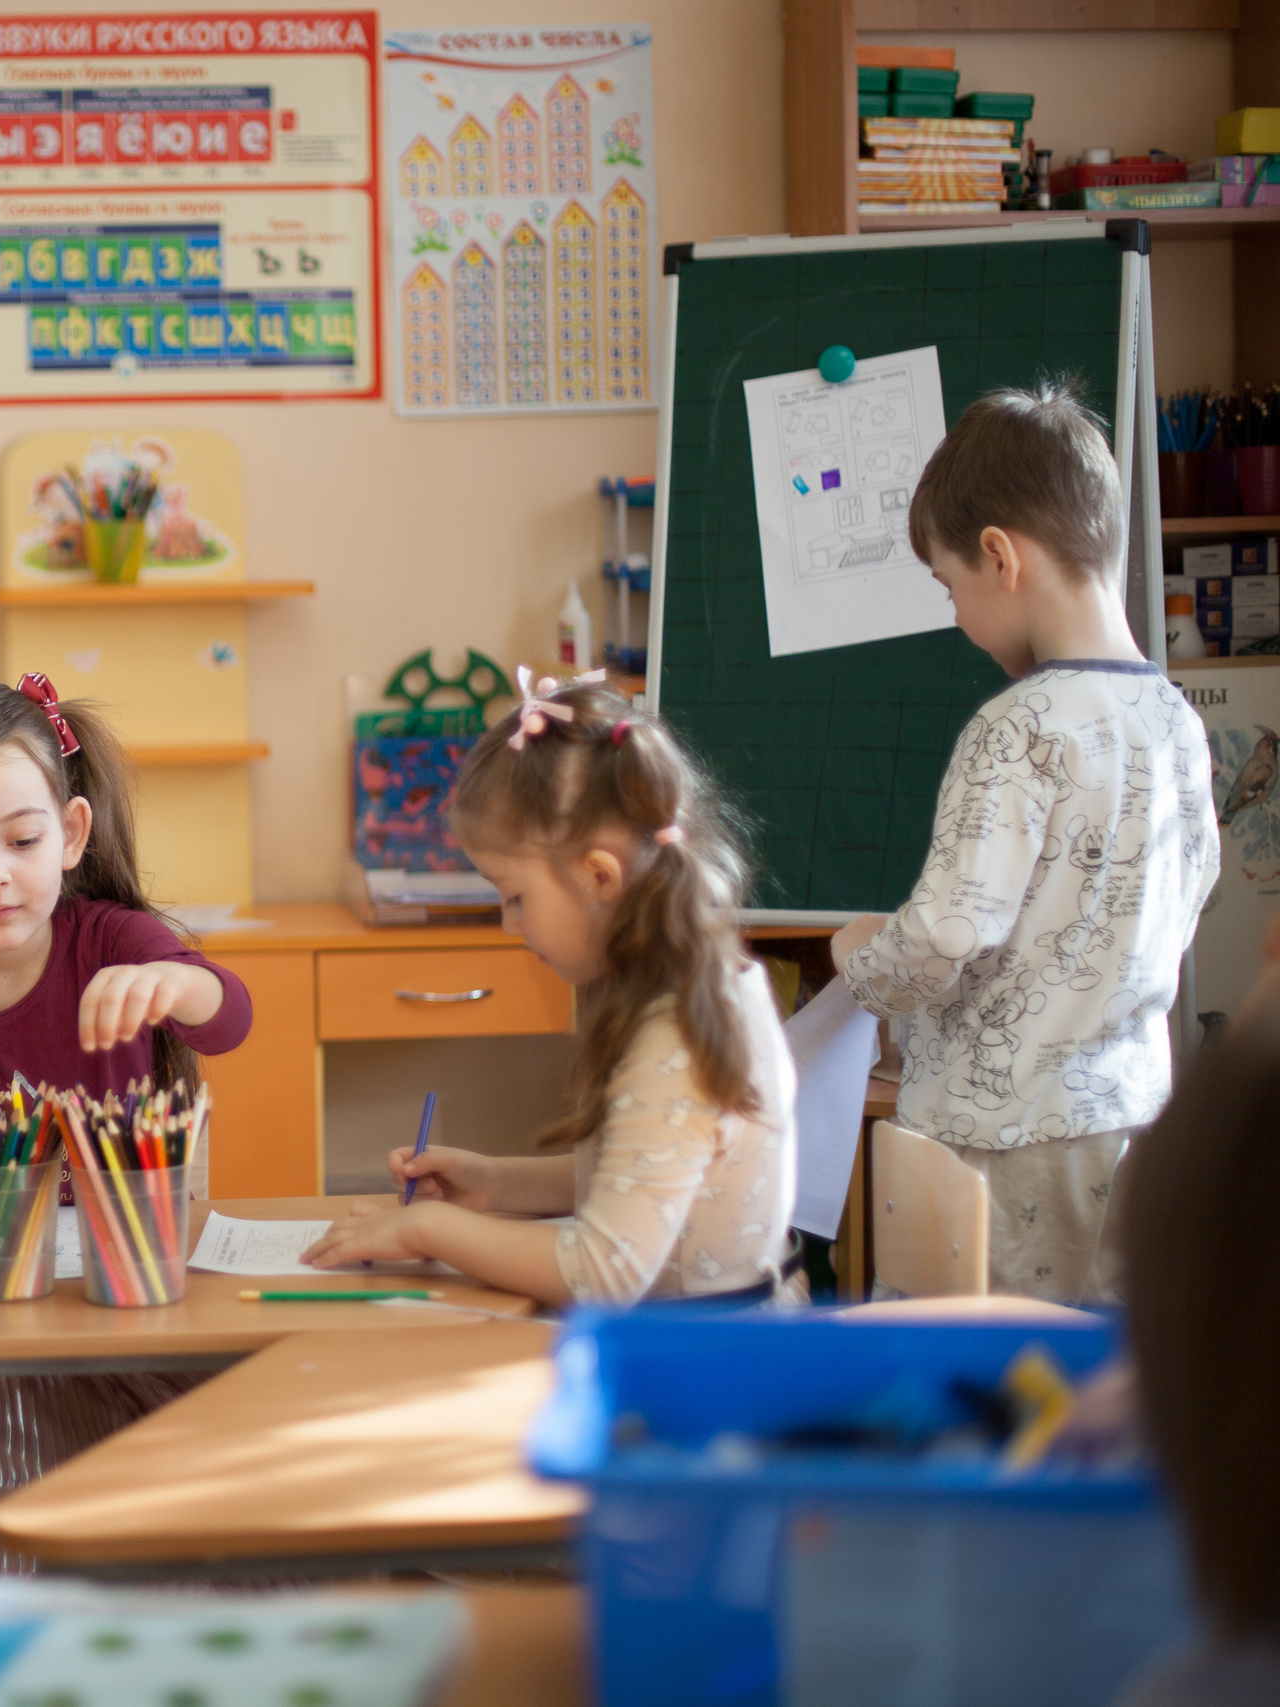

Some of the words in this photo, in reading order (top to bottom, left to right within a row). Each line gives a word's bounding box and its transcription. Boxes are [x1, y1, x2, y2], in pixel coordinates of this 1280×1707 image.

[96, 19, 255, 53] РУССКОГО
[258, 19, 369, 50] ЯЗЫКА
[438, 31, 532, 50] СОСТАВ
[538, 30, 623, 48] ЧИСЛА
